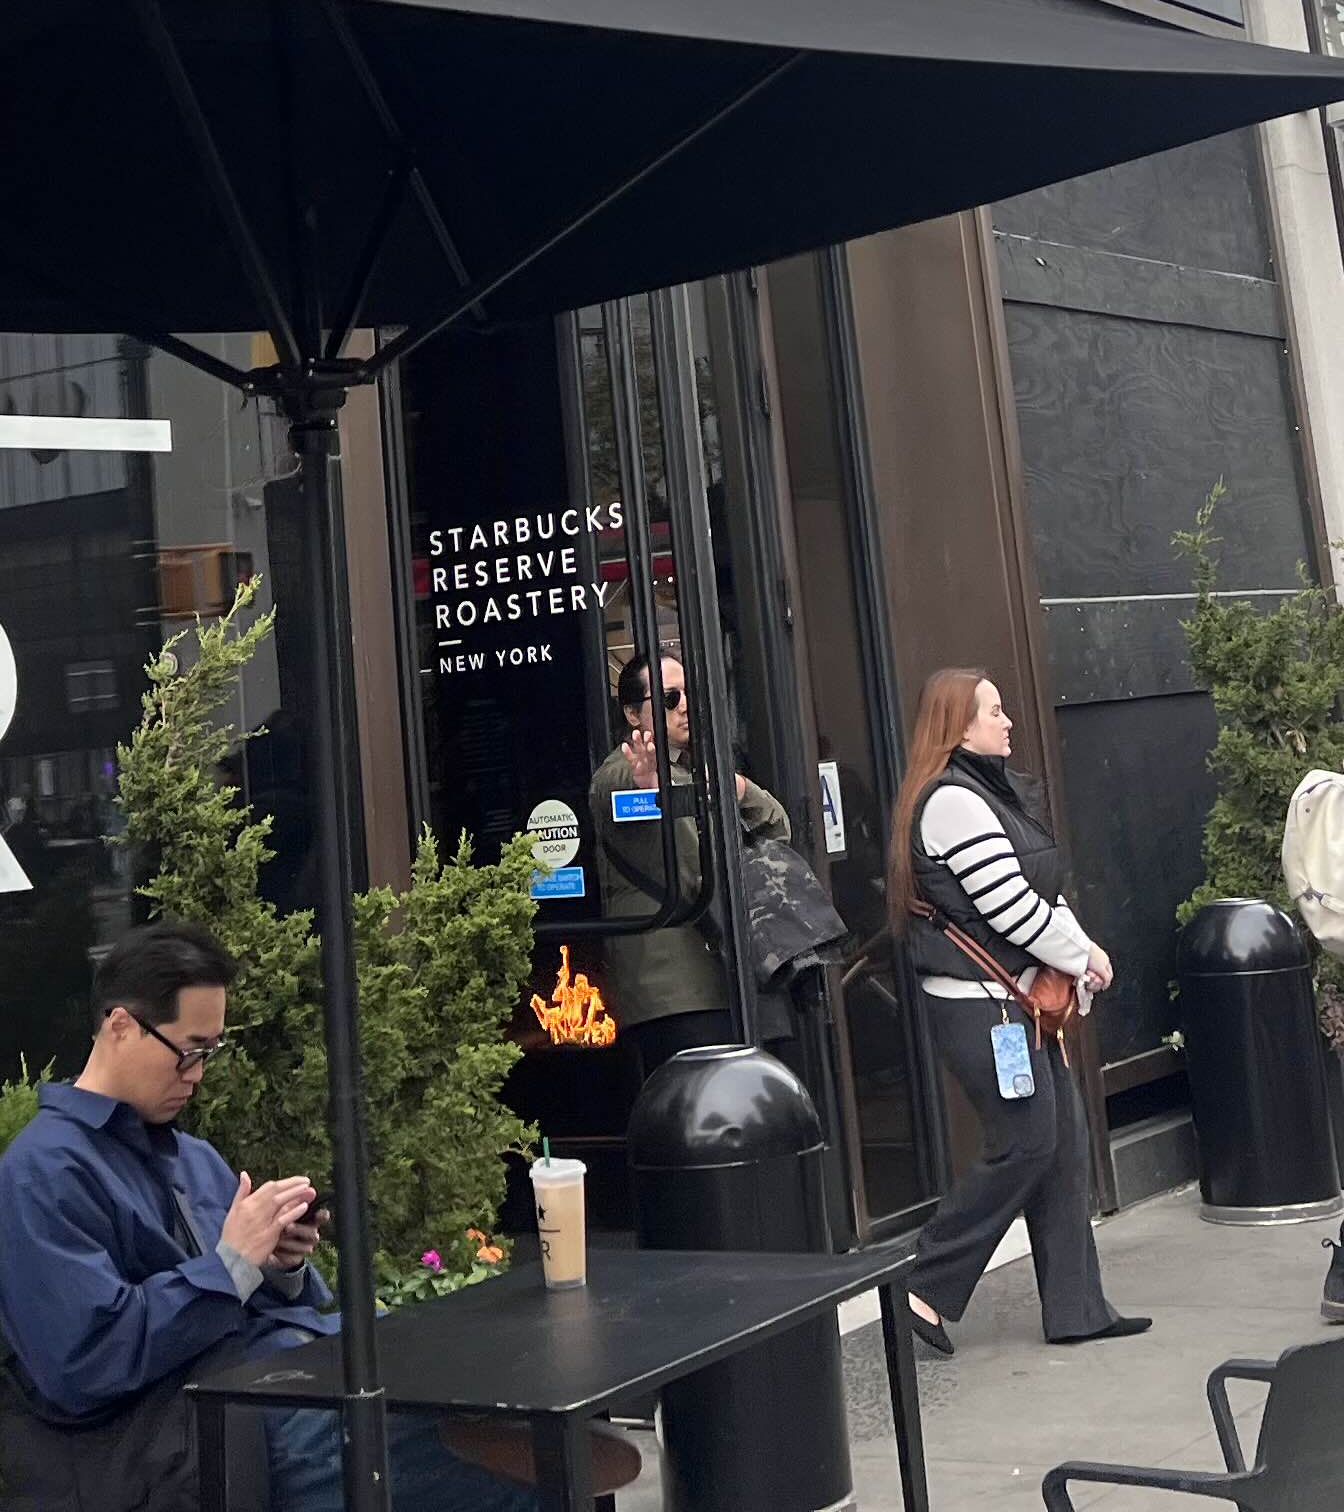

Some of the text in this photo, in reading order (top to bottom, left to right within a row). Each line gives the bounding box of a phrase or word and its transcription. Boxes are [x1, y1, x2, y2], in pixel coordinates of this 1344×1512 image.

[430, 502, 623, 556] STARBUCKS
[433, 548, 577, 592] RESERVE
[436, 583, 608, 629] ROASTERY
[439, 644, 553, 674] NEW YORK
[529, 813, 574, 825] AUTOMATIC
[543, 843, 566, 854] DOOR
